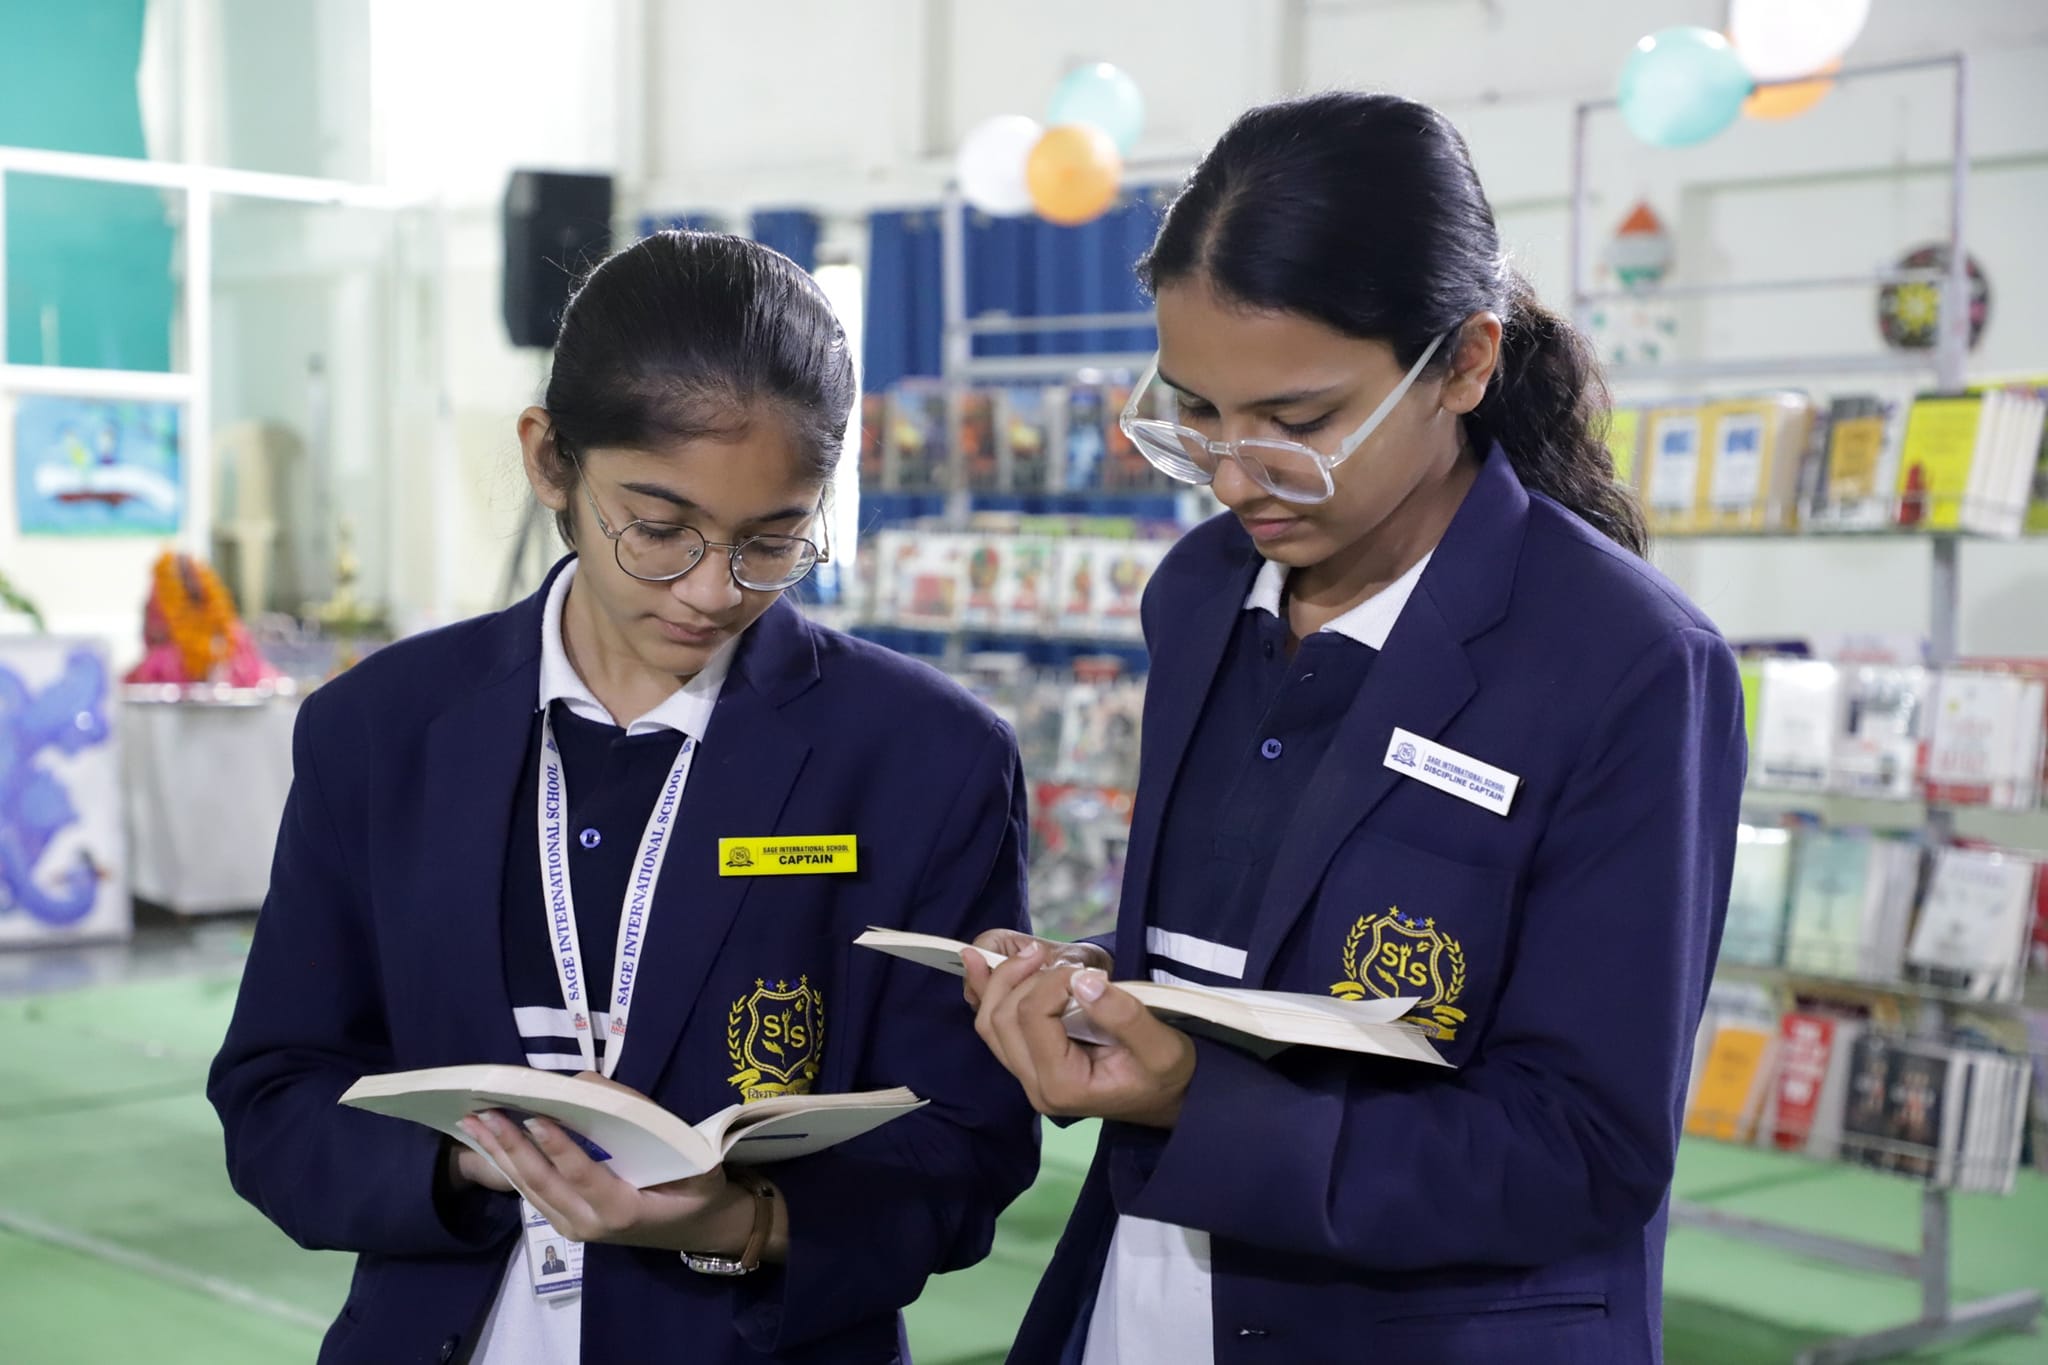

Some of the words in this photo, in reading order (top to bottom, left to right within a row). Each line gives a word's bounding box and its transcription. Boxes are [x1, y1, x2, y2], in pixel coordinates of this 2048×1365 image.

[546, 763, 560, 819] SCHOOL
[657, 764, 685, 824] SCHOOL
[1423, 763, 1467, 787] DISCIPLINE
[1469, 782, 1504, 802] CAPTAIN
[1442, 761, 1484, 783] INTERNATIONAL
[1485, 778, 1506, 793] SCHOOL
[763, 846, 778, 854] SAGE
[779, 845, 824, 854] INTERNATIONAL
[826, 844, 849, 852] SCHOOL
[779, 854, 833, 865] CAPTAIN
[546, 822, 573, 954] INTERNATIONAL
[623, 827, 666, 958] INTERNATIONAL
[562, 956, 579, 1001] SAGE
[617, 961, 634, 1006] SAGE
